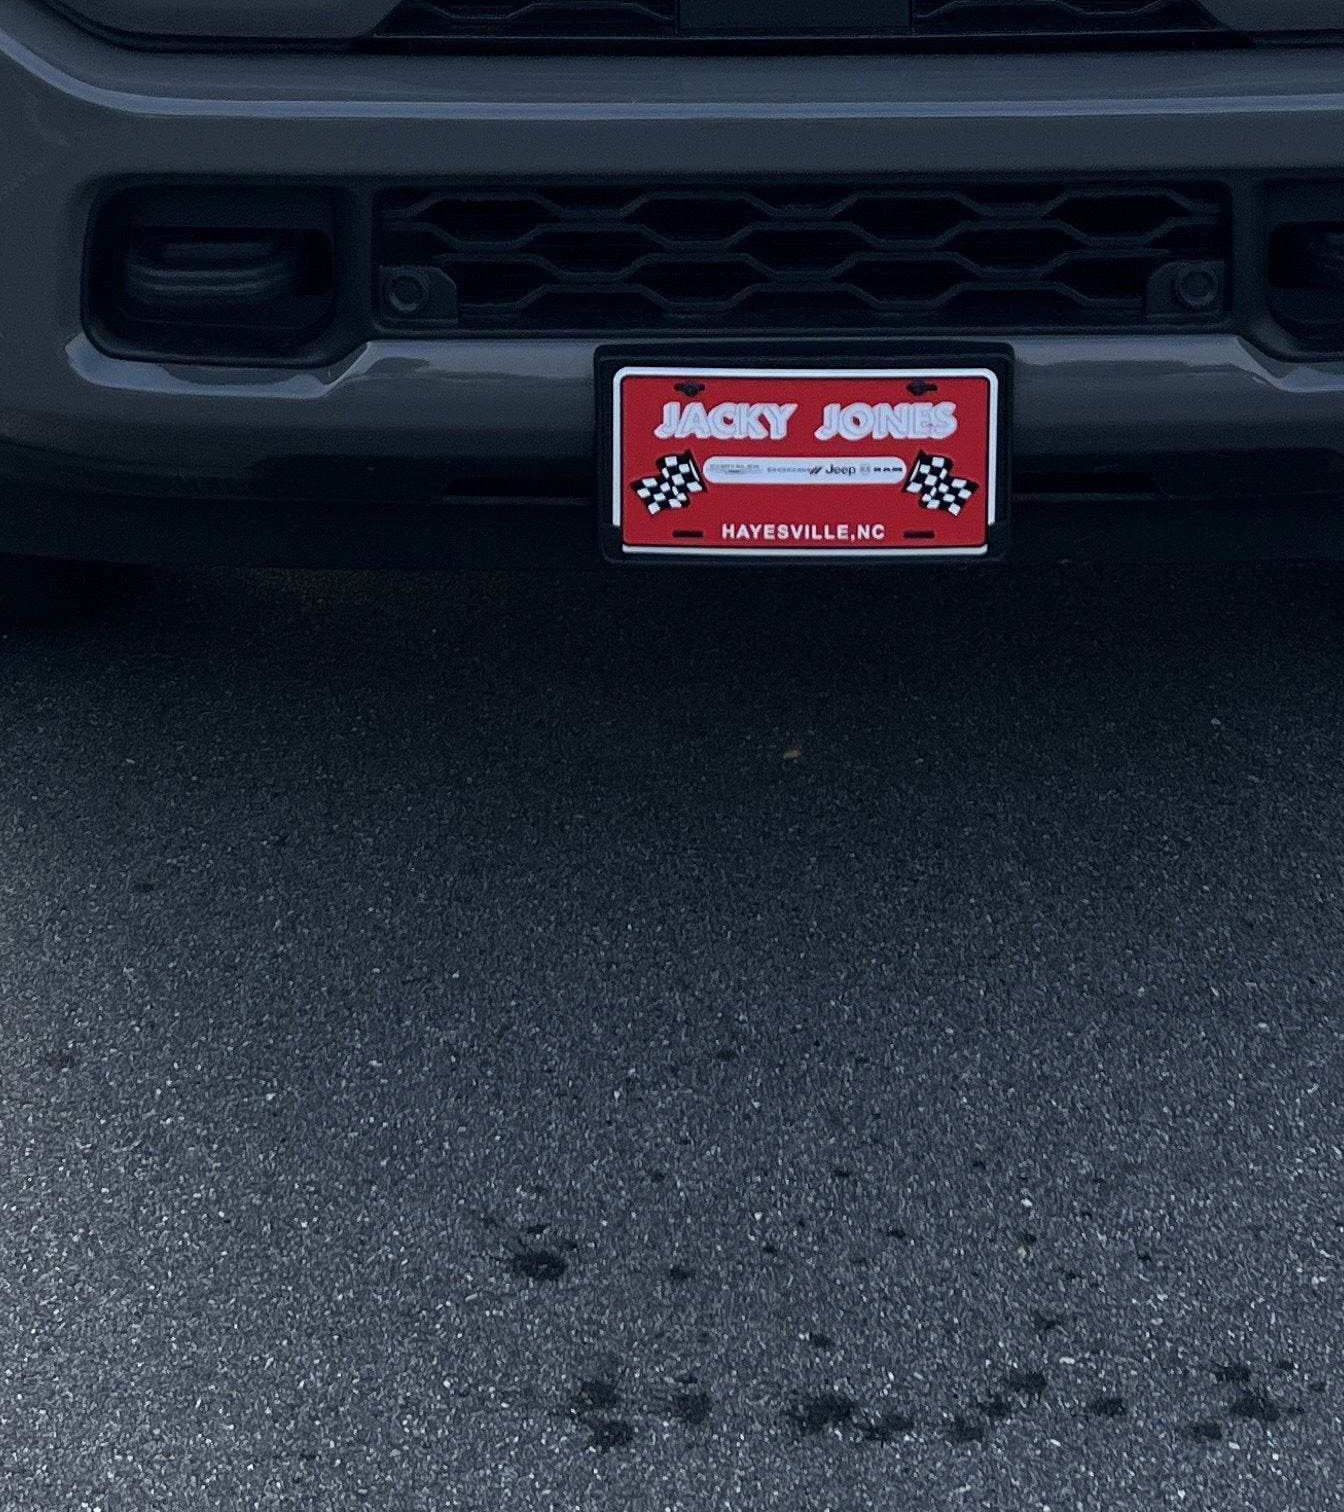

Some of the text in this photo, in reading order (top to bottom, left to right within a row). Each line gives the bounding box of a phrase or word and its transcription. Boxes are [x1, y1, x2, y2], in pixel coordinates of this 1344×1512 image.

[654, 402, 958, 441] JACKY JONES
[825, 464, 856, 476] Jeep
[721, 524, 885, 542] HAYESVILLE,NC
